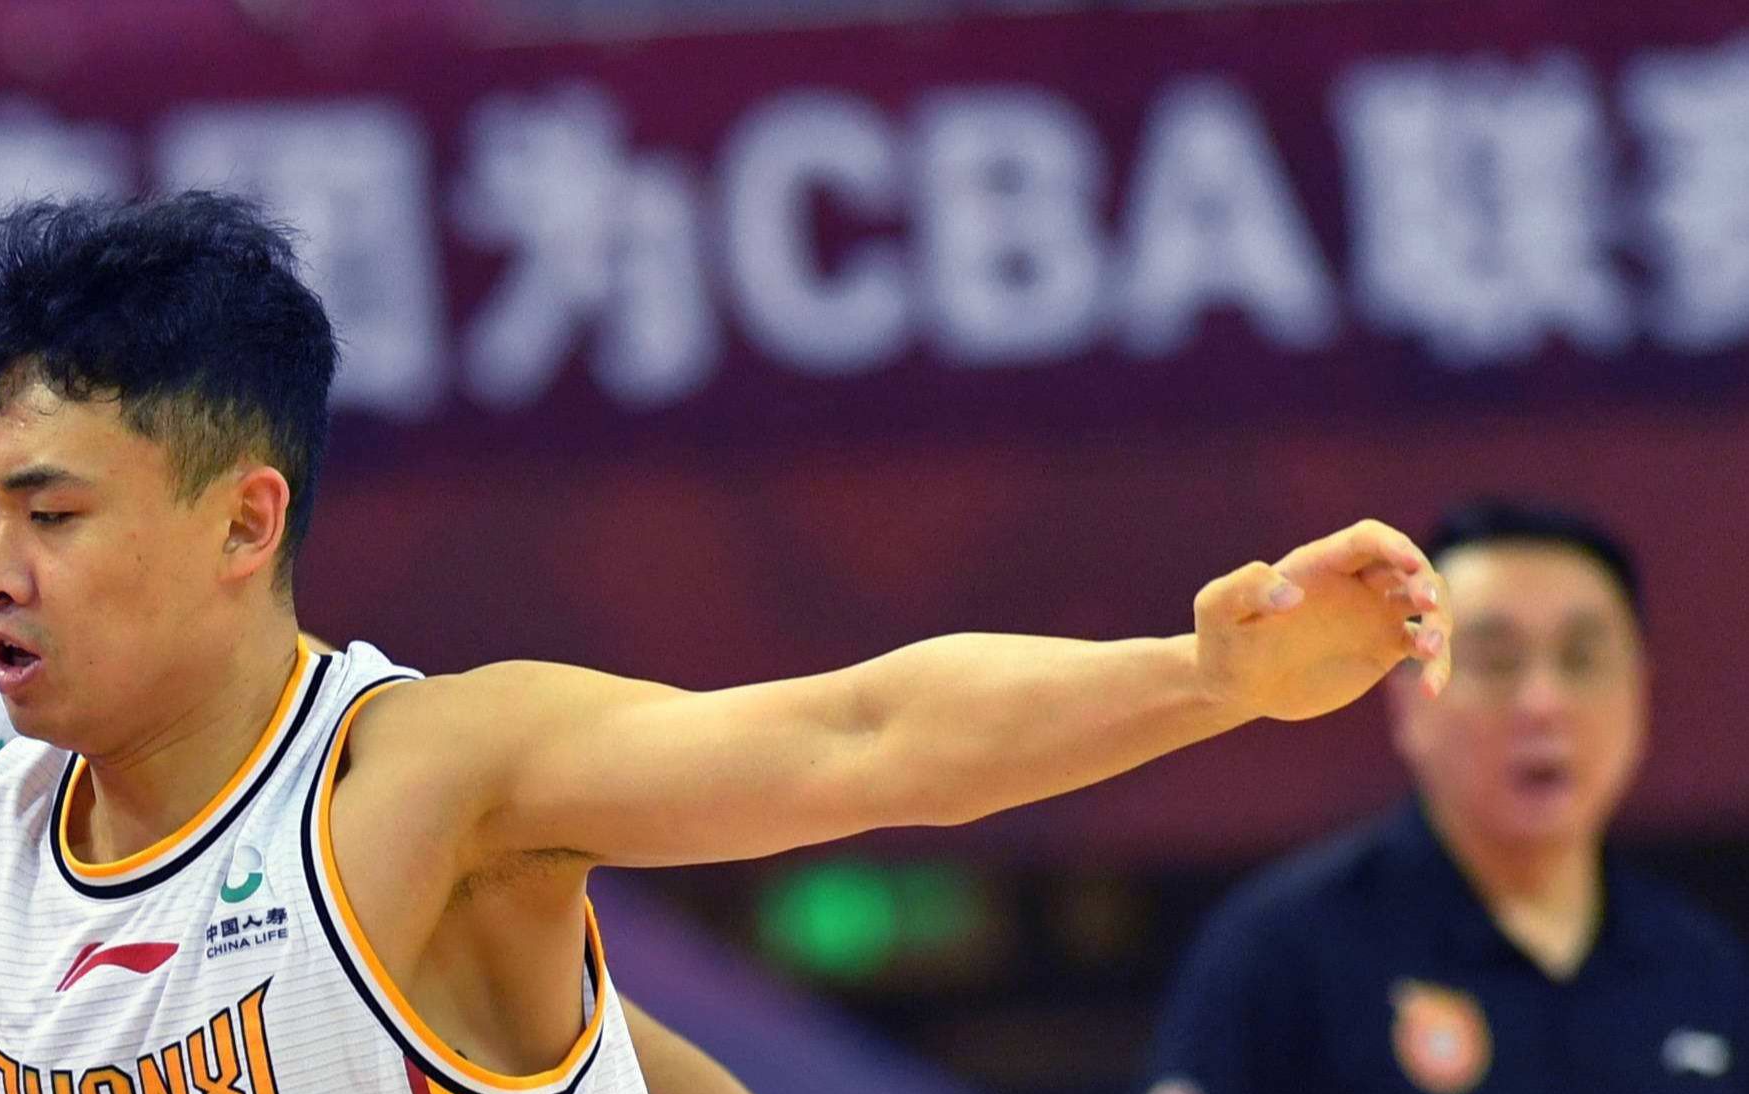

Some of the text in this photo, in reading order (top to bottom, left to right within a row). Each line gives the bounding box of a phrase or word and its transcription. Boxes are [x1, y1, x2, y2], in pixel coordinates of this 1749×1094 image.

[206, 906, 288, 944] 中国人寿
[206, 927, 289, 959] CHINA LIFE
